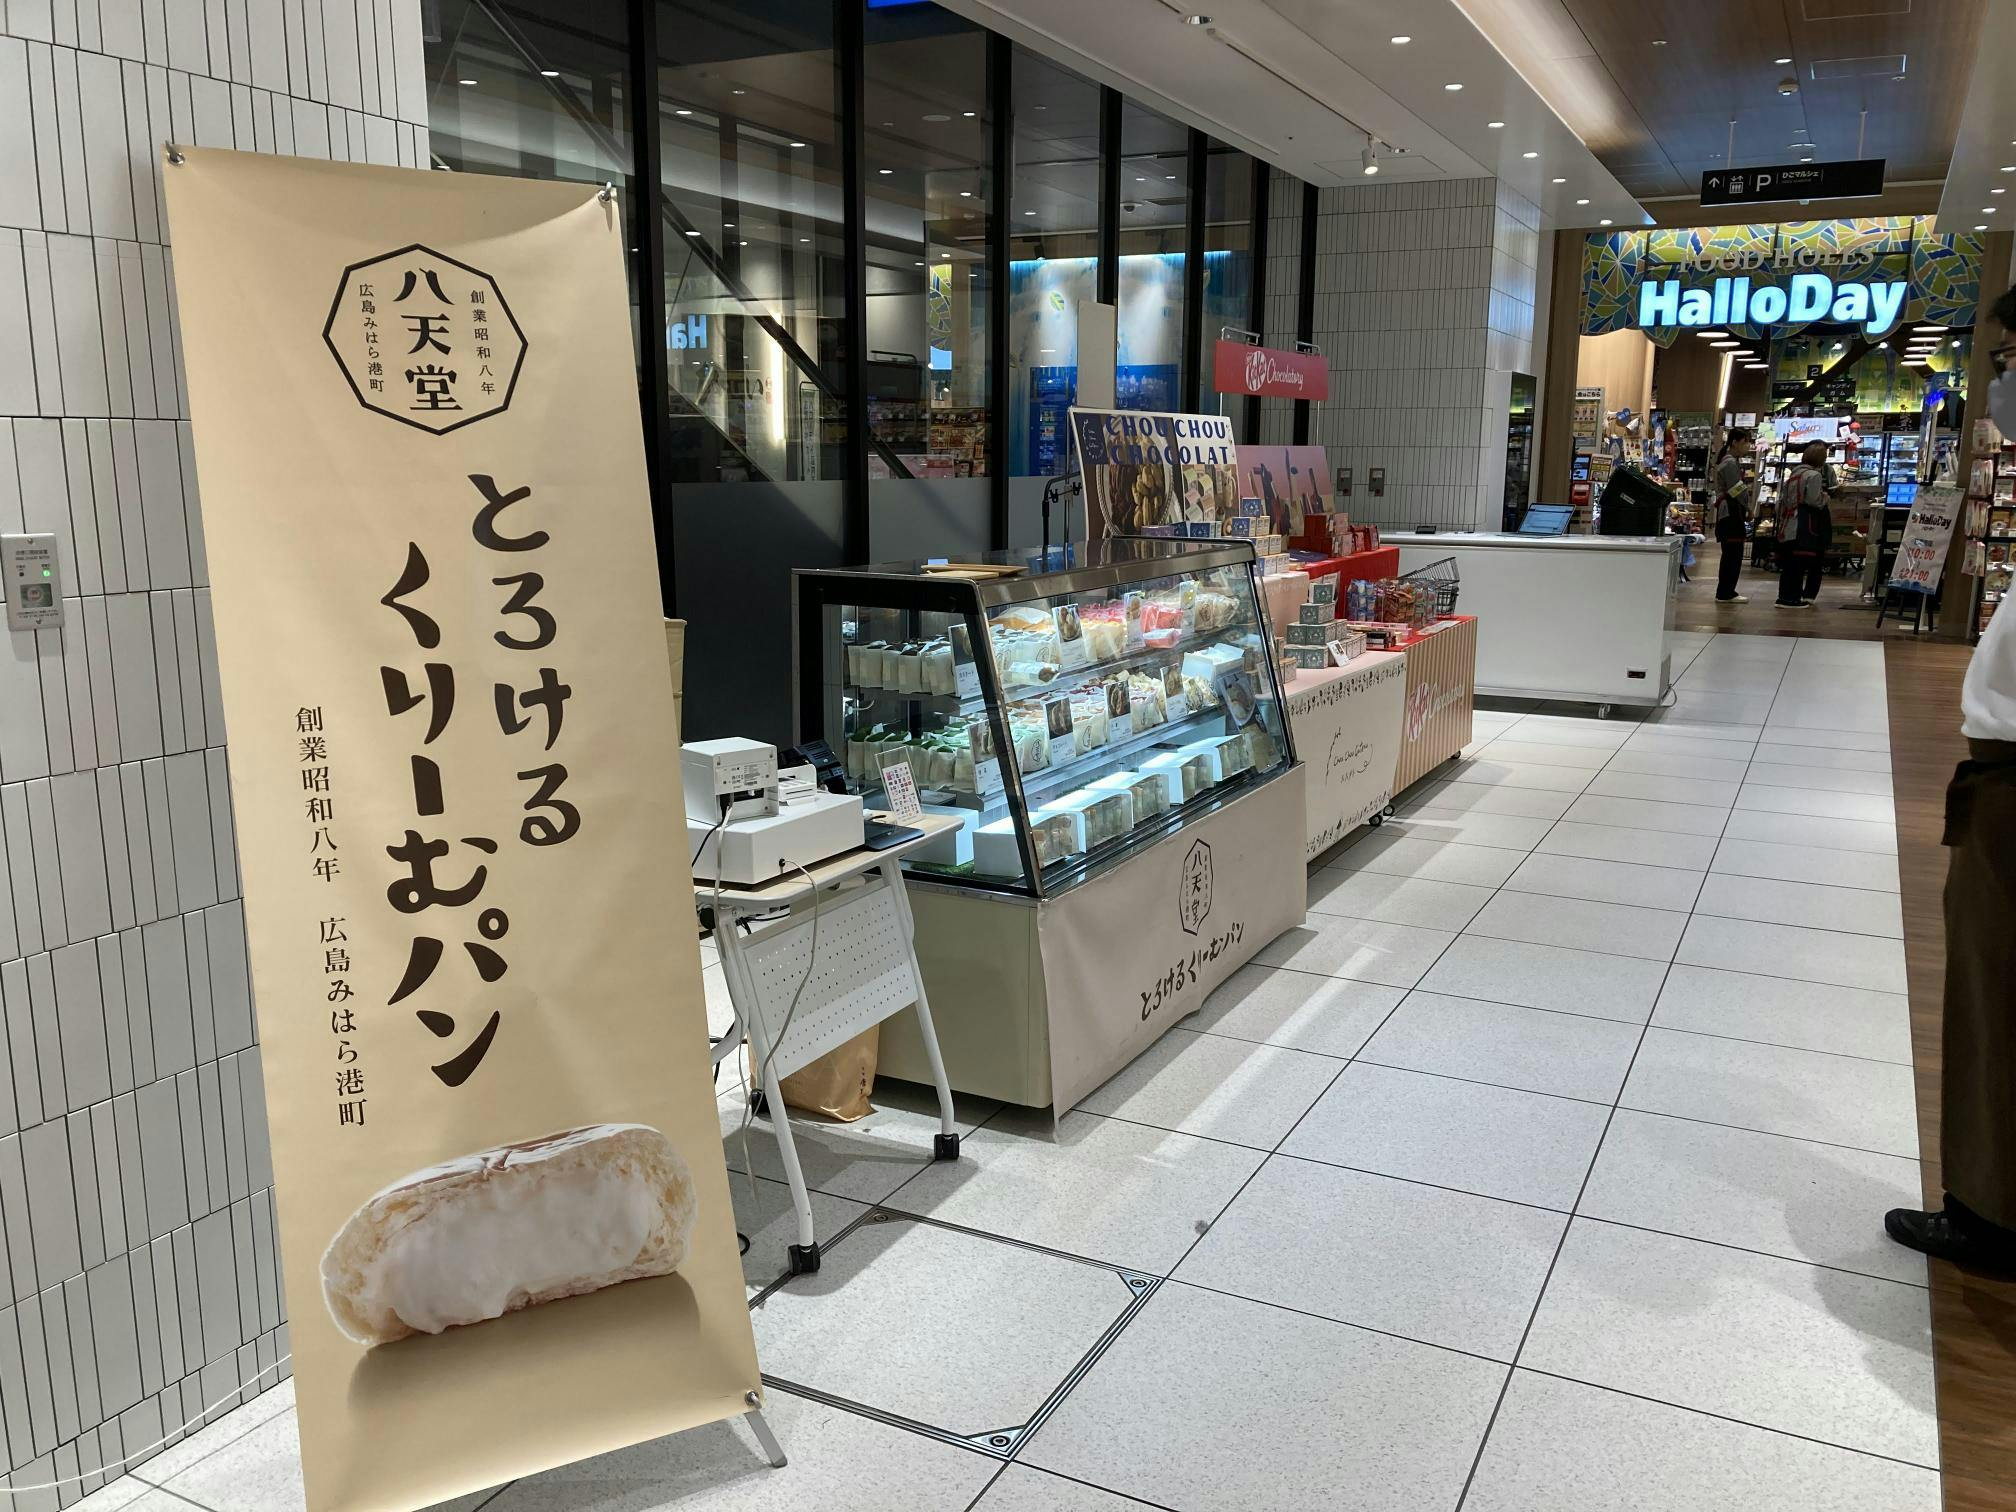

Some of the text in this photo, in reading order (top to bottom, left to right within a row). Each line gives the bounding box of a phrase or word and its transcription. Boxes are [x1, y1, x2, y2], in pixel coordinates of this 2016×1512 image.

[1755, 174, 1772, 192] P
[1639, 273, 1908, 334] HalloDay
[1679, 249, 1765, 273] FOOD
[359, 283, 384, 393] 広島みはら港町
[392, 267, 463, 411] 八天堂
[470, 290, 495, 395] 創業昭和八年
[1105, 415, 1226, 439] CHOU CHOU
[1110, 445, 1228, 465] CHOCOLAT
[467, 473, 581, 847] とろける
[380, 541, 510, 1088] くりーむパン
[295, 706, 367, 1127] 創業昭和八年 広島みはら港町
[1191, 850, 1202, 926] 八天堂
[1141, 921, 1244, 1021] とろけるくりーむパン
